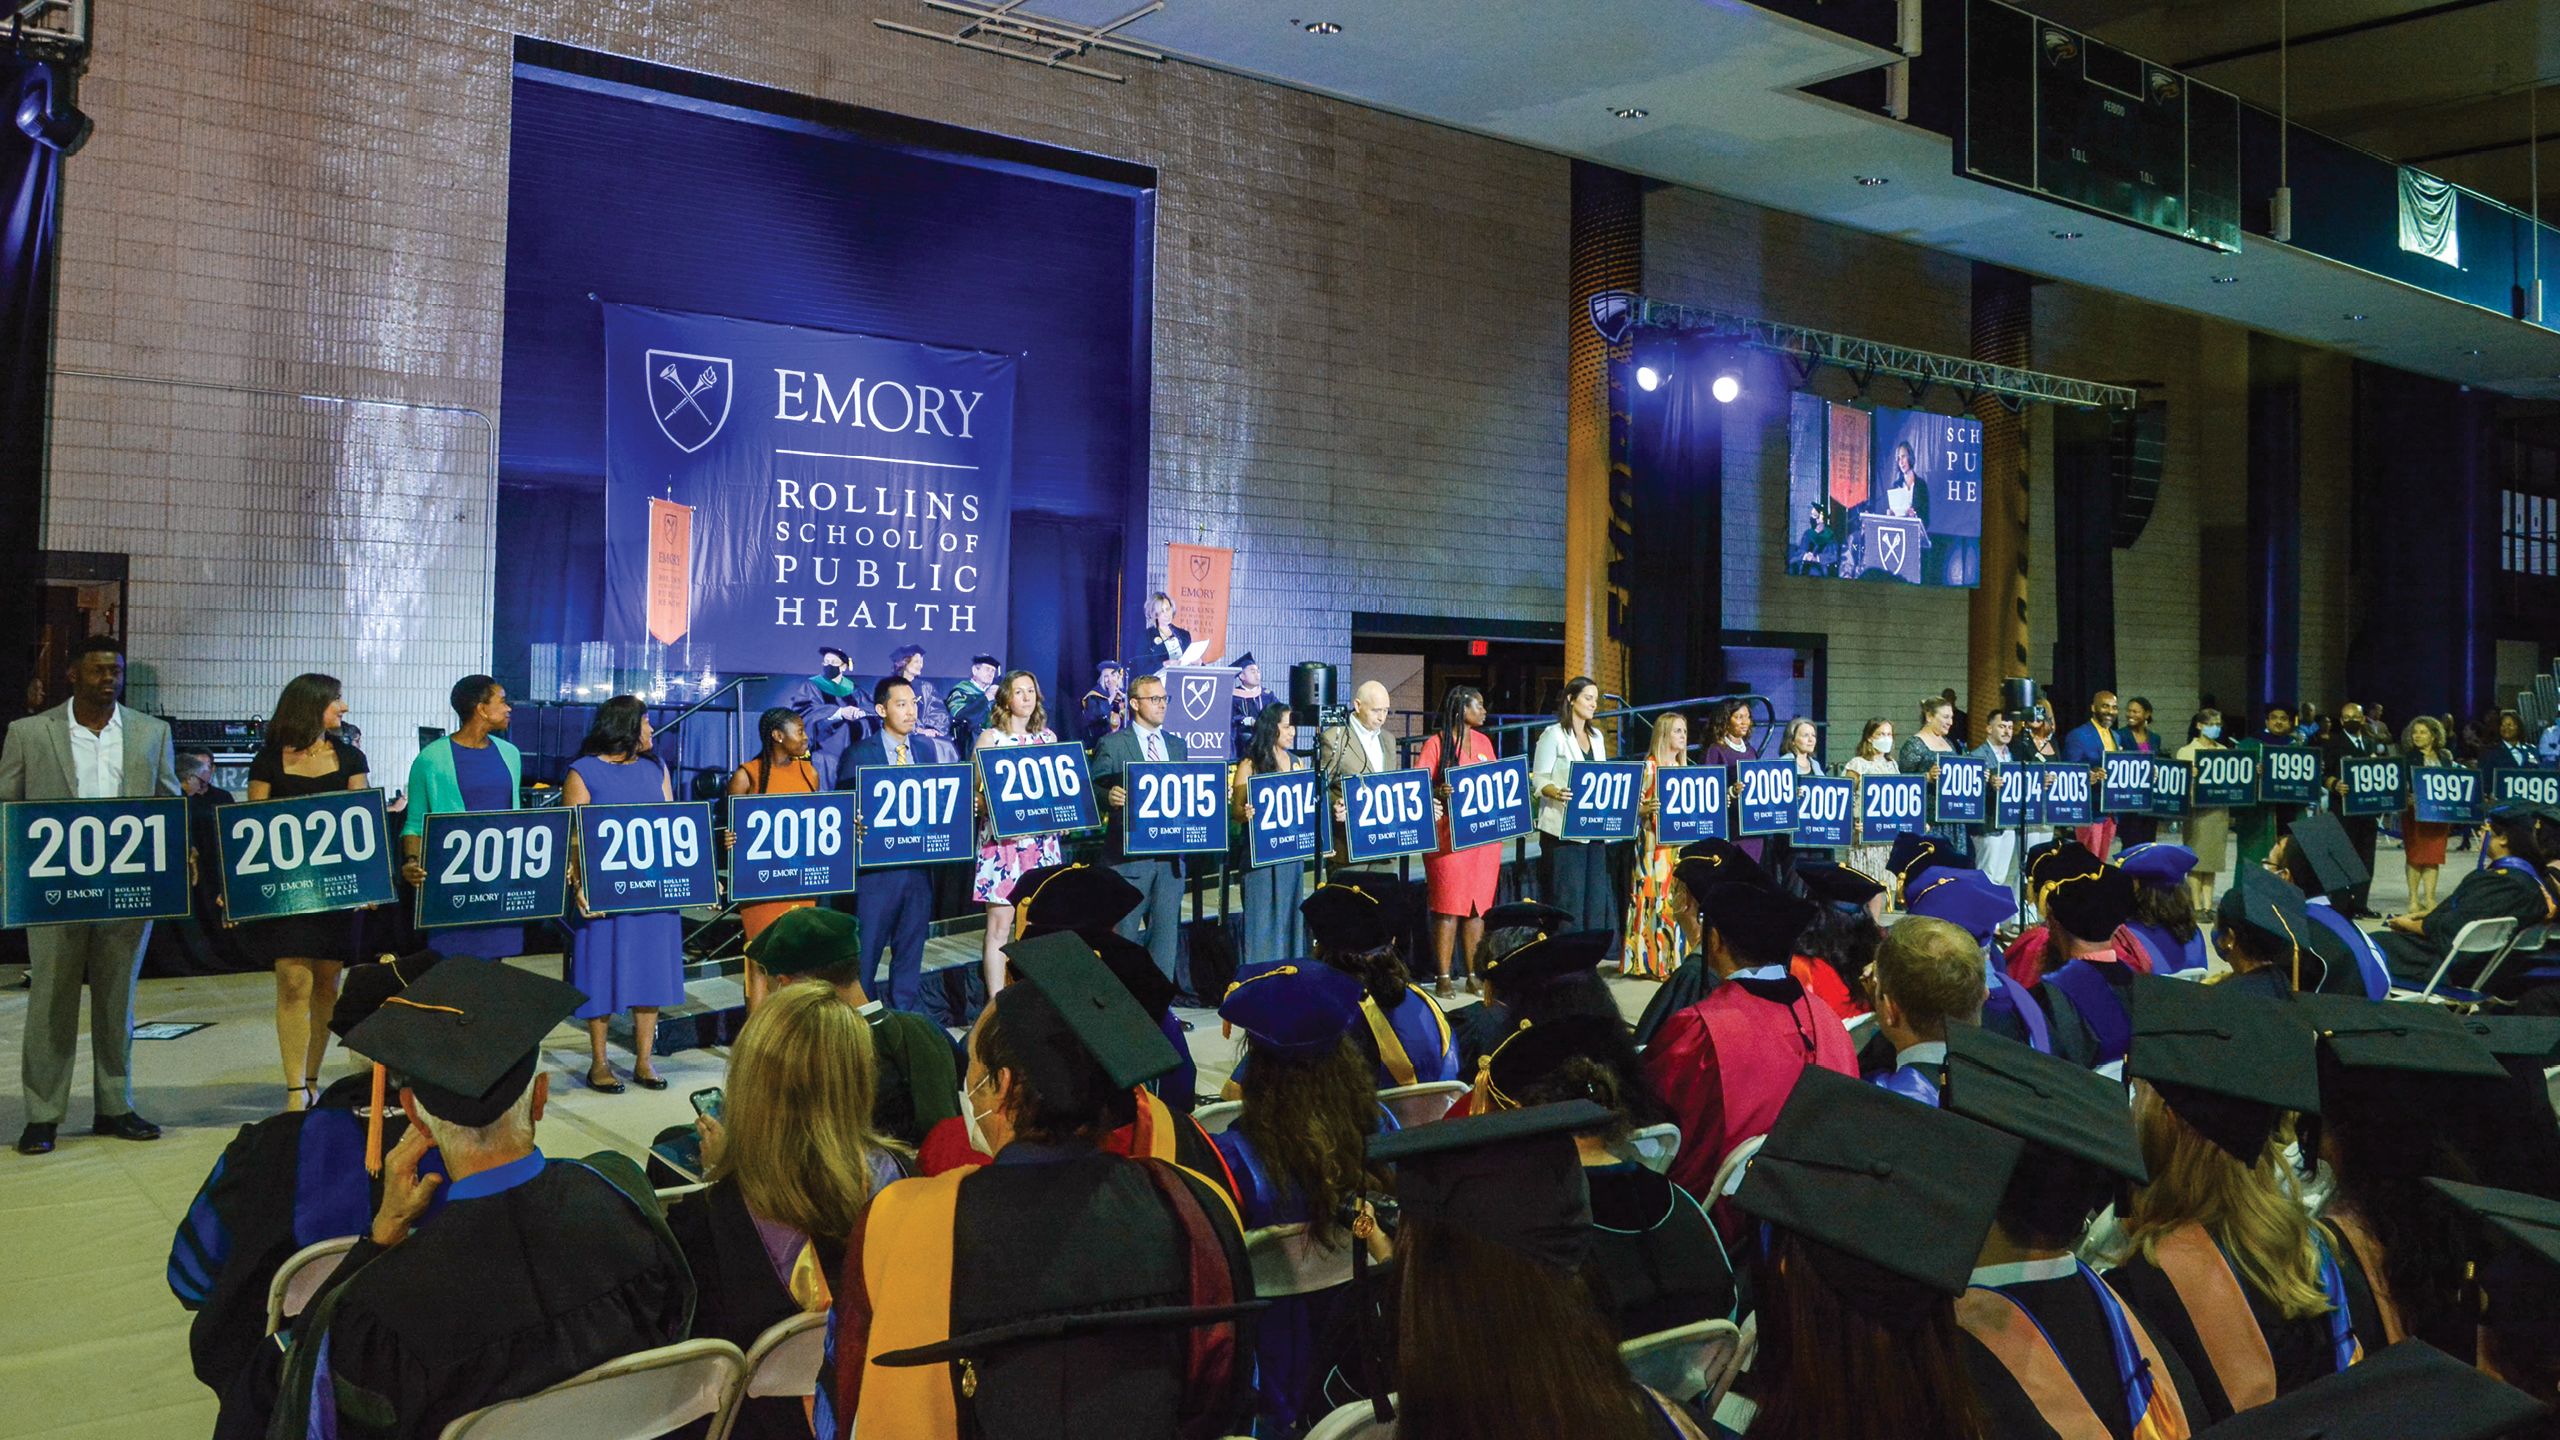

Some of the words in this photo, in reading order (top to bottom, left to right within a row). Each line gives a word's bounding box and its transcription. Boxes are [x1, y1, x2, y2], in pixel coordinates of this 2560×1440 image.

[774, 368, 983, 438] EMORY
[1946, 427, 1980, 444] SCH
[1947, 451, 1977, 472] PU
[777, 479, 979, 521] ROLLINS
[1947, 480, 1977, 502] HE
[776, 521, 922, 550] SCHOOL
[940, 532, 978, 553] OF
[775, 555, 977, 592] PUBLIC
[1181, 586, 1215, 599] EMORY
[776, 597, 977, 632] HEALTH
[1169, 731, 1225, 749] MORY
[994, 754, 1081, 802] 2016
[1941, 763, 1983, 797] 2005
[2107, 759, 2151, 789] 2002
[2198, 756, 2253, 785] 2000
[2269, 752, 2315, 781] 1999
[2350, 763, 2399, 793] 1998
[1138, 773, 1216, 819] 2015
[1458, 768, 1522, 818] 2012
[1578, 771, 1632, 810] 2011
[1665, 776, 1720, 815] 2010
[1744, 767, 1794, 806] 2009
[1866, 783, 1922, 818] 2006
[2048, 771, 2088, 802] 2003
[2422, 773, 2475, 802] 1997
[2504, 776, 2558, 804] 1996
[873, 777, 960, 828] 2017
[1027, 807, 1049, 817] EMORY
[1259, 782, 1315, 830] 2014
[1356, 781, 1423, 826] 2013
[1797, 784, 1850, 821] 2007
[28, 814, 167, 878] 2021
[232, 805, 376, 876] 2020
[597, 816, 699, 871] 2019
[746, 806, 842, 861] 2018
[897, 835, 921, 845] EMORY
[440, 825, 553, 884] 2019
[280, 879, 315, 891] EMORY
[323, 873, 357, 882] ROLLINS
[324, 883, 358, 892] PUBLIC
[629, 880, 657, 889] EMORY
[772, 868, 799, 878] EMORY
[67, 888, 105, 899] EMORY
[325, 888, 359, 898] HEALTH
[469, 893, 500, 903] EMORY
